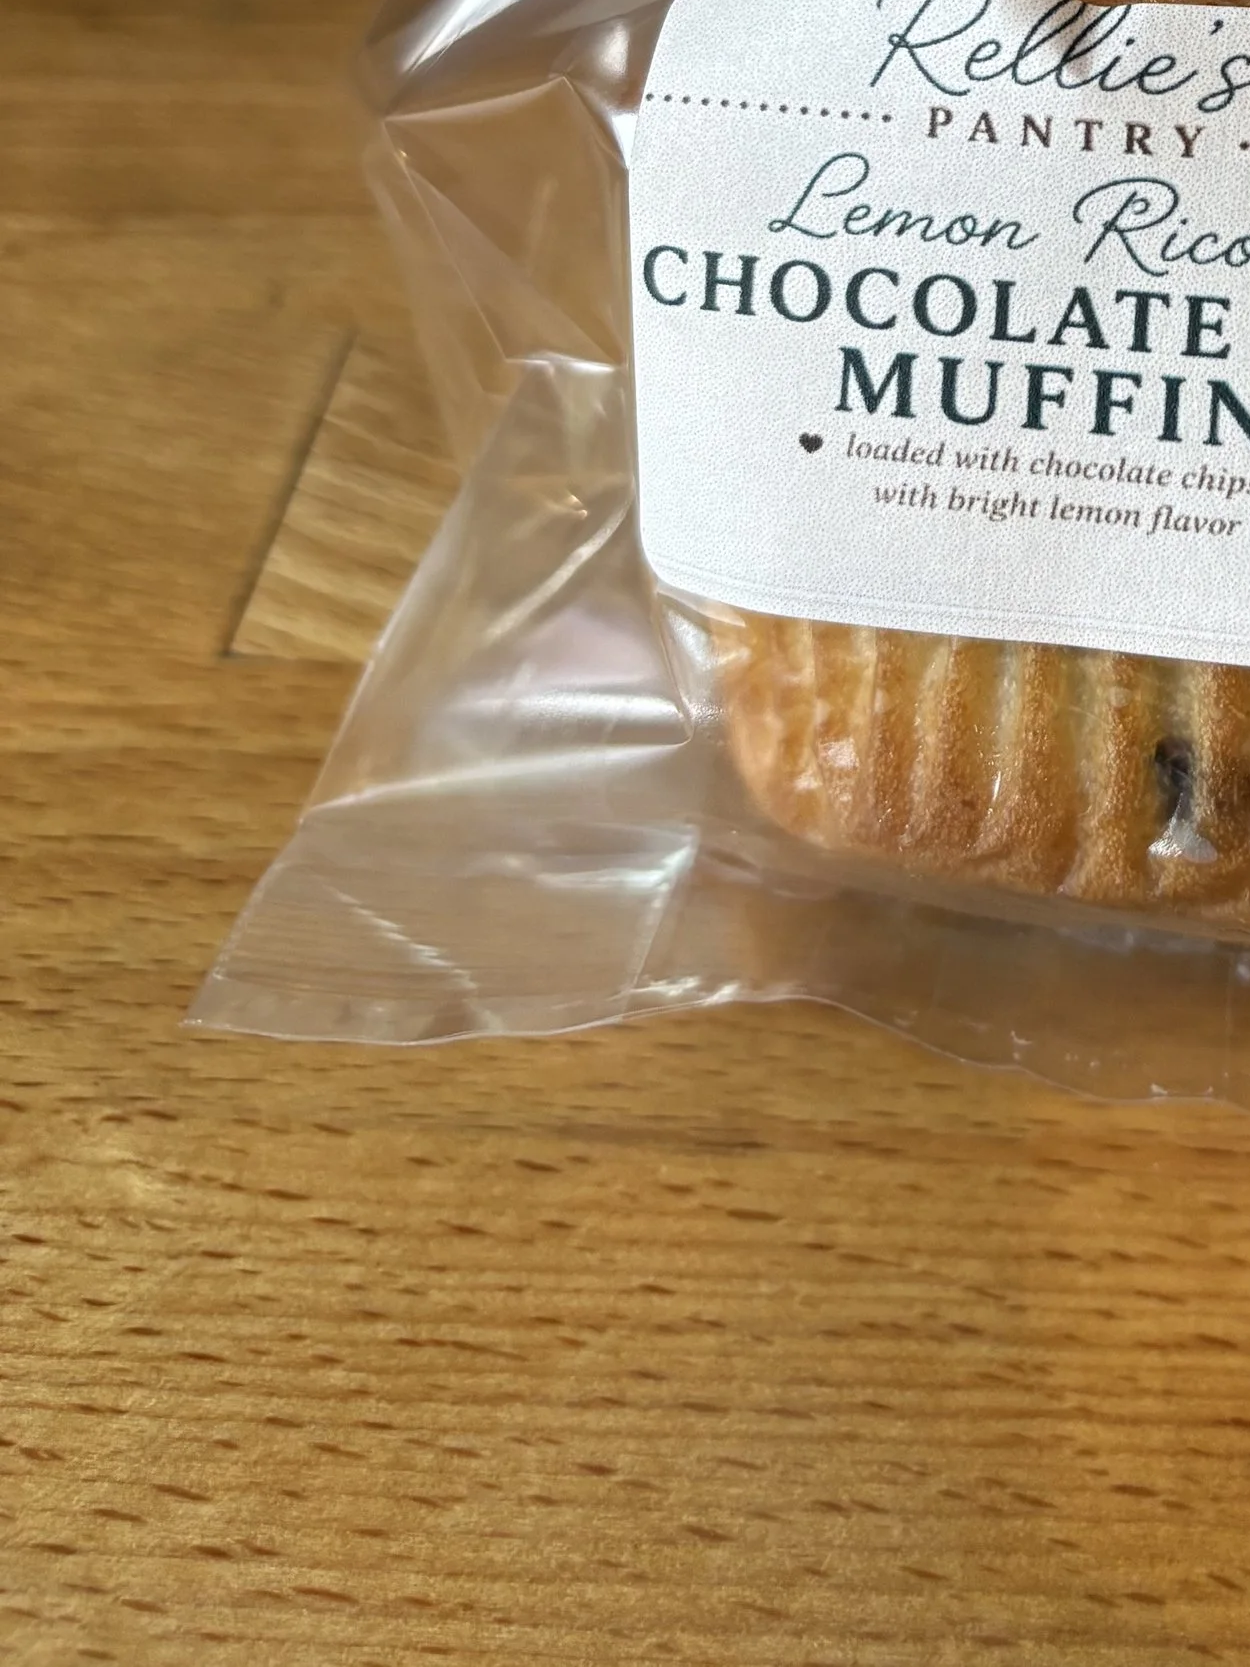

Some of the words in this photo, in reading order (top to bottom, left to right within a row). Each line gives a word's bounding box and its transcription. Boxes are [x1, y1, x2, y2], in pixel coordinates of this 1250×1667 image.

[926, 106, 1208, 159] PANTRY
[767, 152, 1039, 251] Lemon
[641, 244, 1234, 361] CHOCOLATE
[846, 433, 944, 468] loaded
[955, 444, 1020, 475] with
[1029, 451, 1173, 490] chocolate
[873, 481, 938, 512] with
[947, 485, 1040, 523] bright
[1049, 498, 1142, 529] lemon
[1146, 505, 1243, 537] flavor
